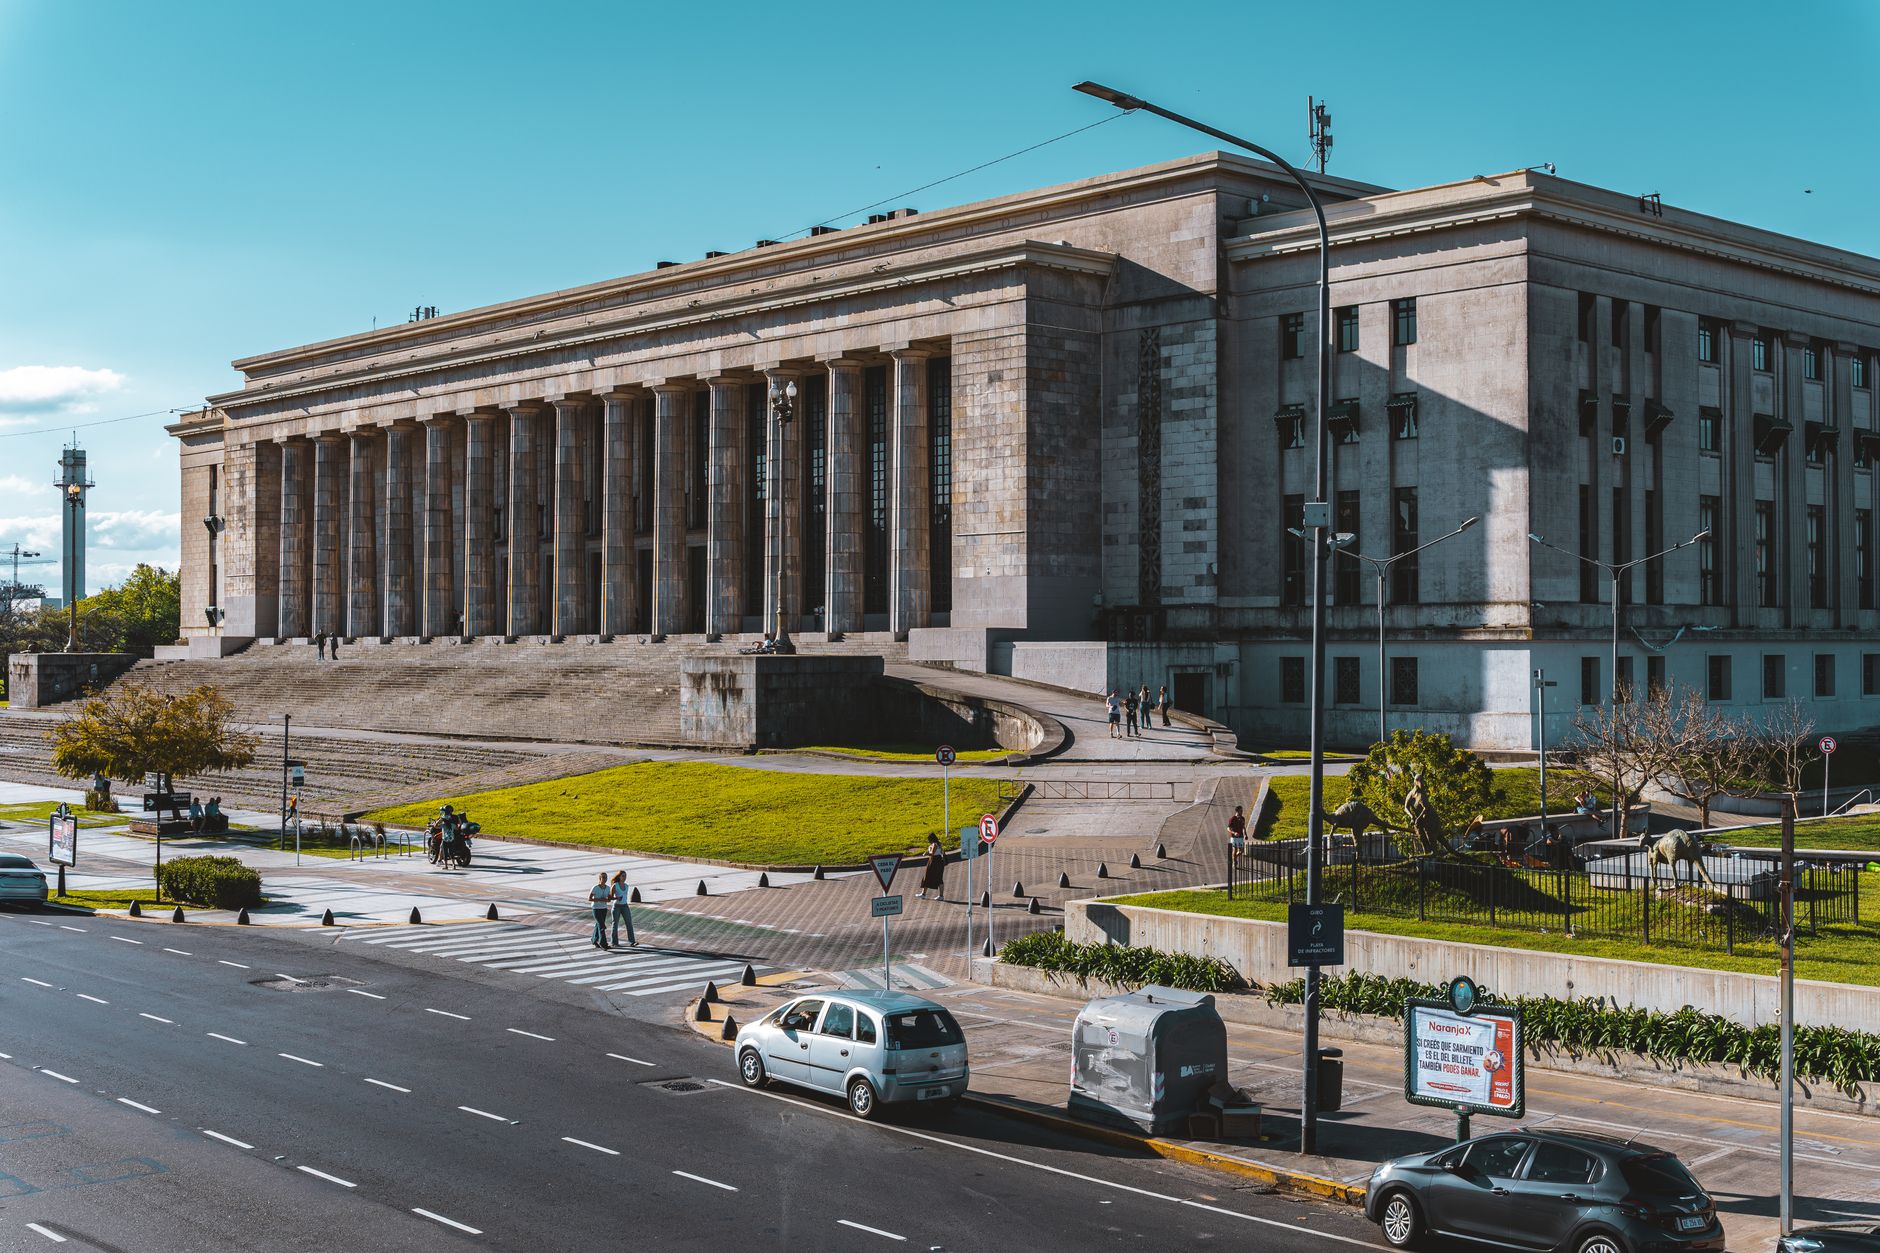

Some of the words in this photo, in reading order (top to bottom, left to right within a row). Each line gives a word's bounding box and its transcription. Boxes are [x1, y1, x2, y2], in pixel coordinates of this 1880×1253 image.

[1440, 1041, 1452, 1051] QUE
[1452, 1043, 1484, 1056] SARMIENTO
[1425, 1050, 1433, 1059] ES
[1433, 1051, 1440, 1060] EL
[1440, 1052, 1451, 1062] DEL
